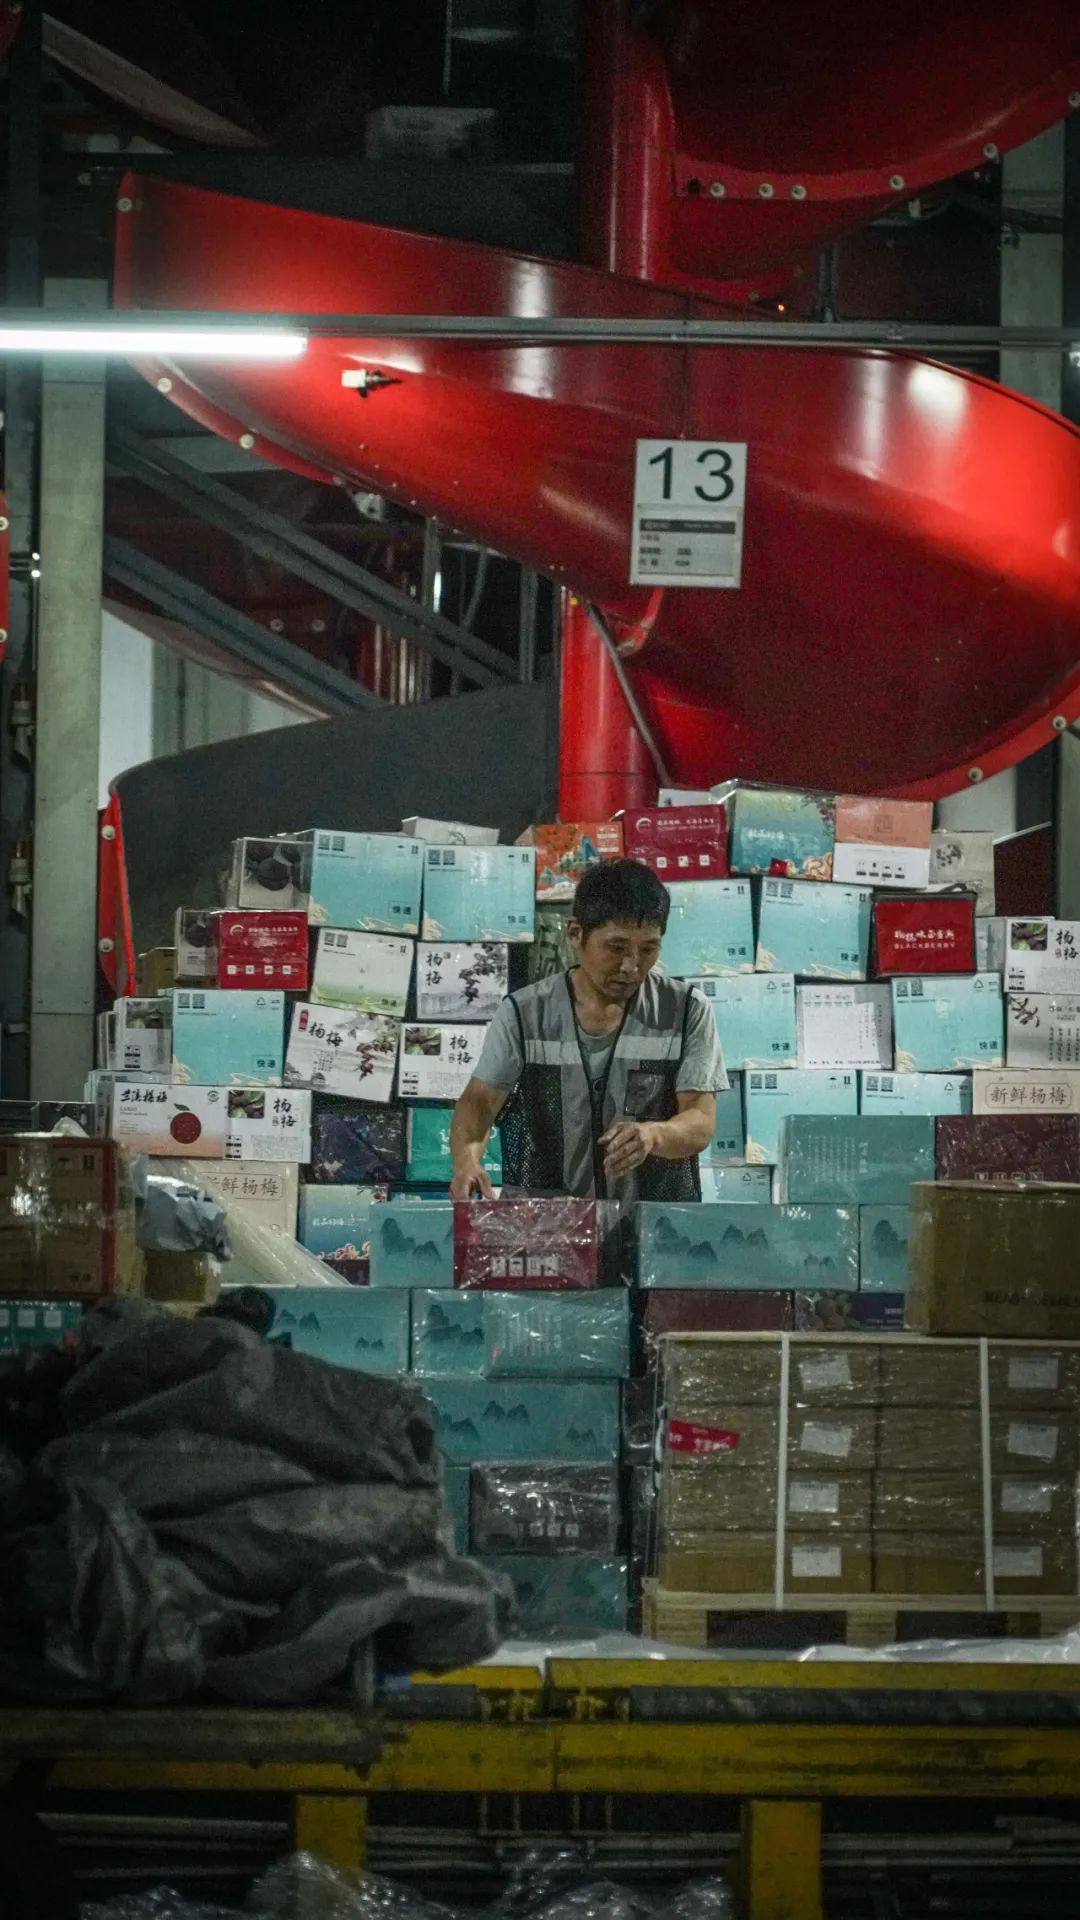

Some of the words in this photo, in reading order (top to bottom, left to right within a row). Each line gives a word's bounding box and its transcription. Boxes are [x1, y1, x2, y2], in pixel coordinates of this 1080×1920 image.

[649, 447, 734, 502] 13
[1056, 929, 1079, 960] 杨梅
[426, 953, 443, 986] 杨梅
[308, 1021, 344, 1047] 杨梅
[449, 1034, 473, 1065] 杨梅
[991, 1086, 1067, 1105] 新鲜杨梅
[273, 1098, 297, 1128] 杨梅
